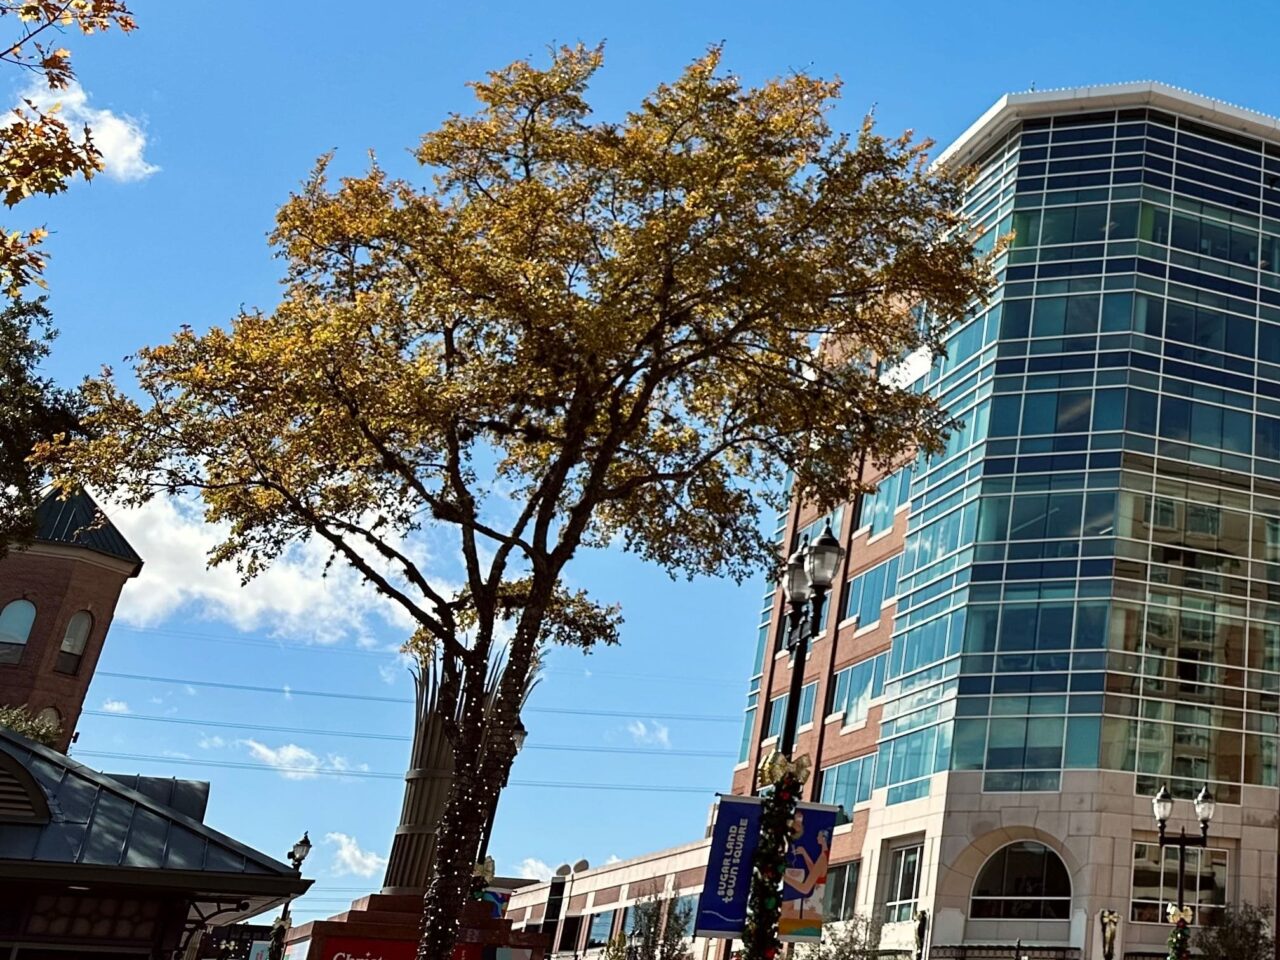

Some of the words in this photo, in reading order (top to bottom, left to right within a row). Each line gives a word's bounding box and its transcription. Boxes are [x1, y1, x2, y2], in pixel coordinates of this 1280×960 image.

[724, 825, 738, 856] LAND
[732, 818, 748, 863] SQUARE
[717, 857, 732, 896] SUGAR
